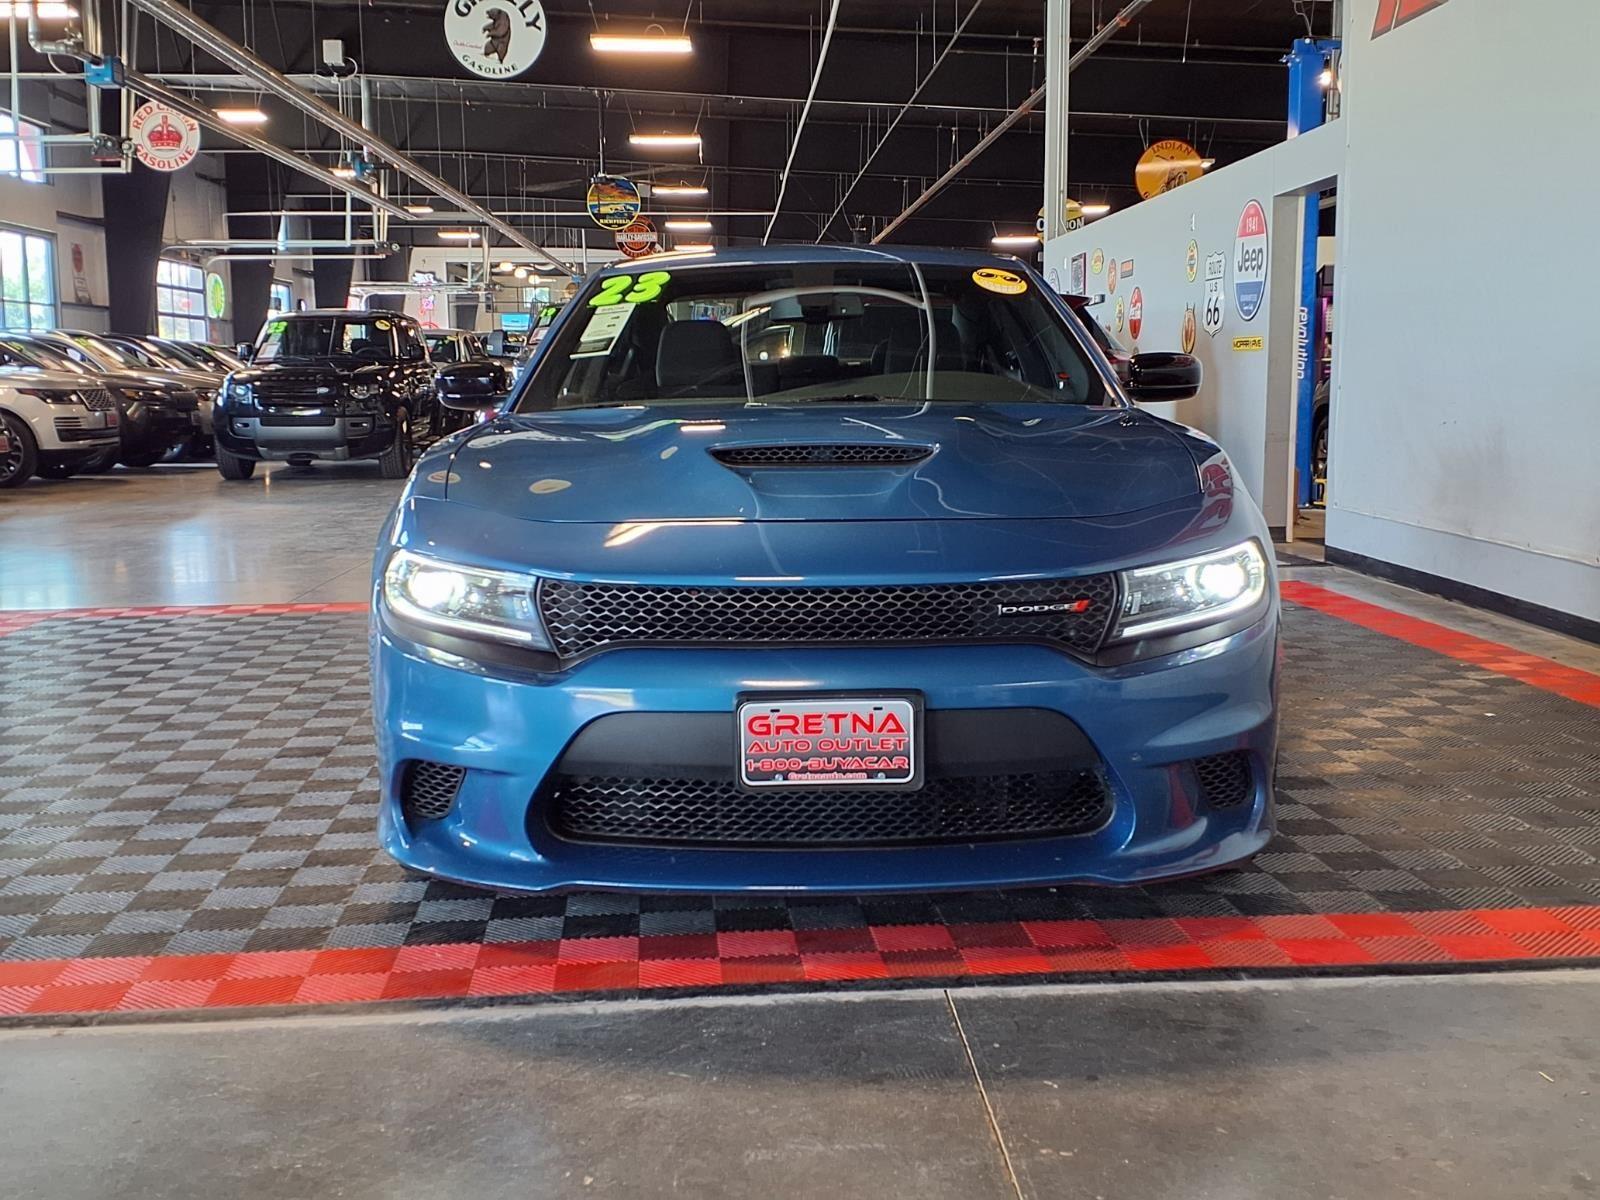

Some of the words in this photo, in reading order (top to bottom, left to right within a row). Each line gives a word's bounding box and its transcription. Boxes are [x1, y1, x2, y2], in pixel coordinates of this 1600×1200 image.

[462, 54, 518, 74] GASOLINE
[132, 105, 154, 130] RED
[136, 143, 195, 169] GASOLINE
[1151, 141, 1193, 156] INDIAN
[1246, 215, 1259, 233] 1941
[1208, 260, 1222, 275] ROUTE
[1237, 242, 1264, 278] Jeep
[588, 271, 671, 306] 23
[1206, 296, 1220, 326] 66
[1297, 306, 1309, 379] revolution
[997, 603, 1078, 616] DODGE
[747, 712, 906, 736] GRETNA
[747, 740, 811, 754] AUTO
[818, 738, 908, 751] OUTLET
[746, 756, 909, 772] 1-800-BUYACAR
